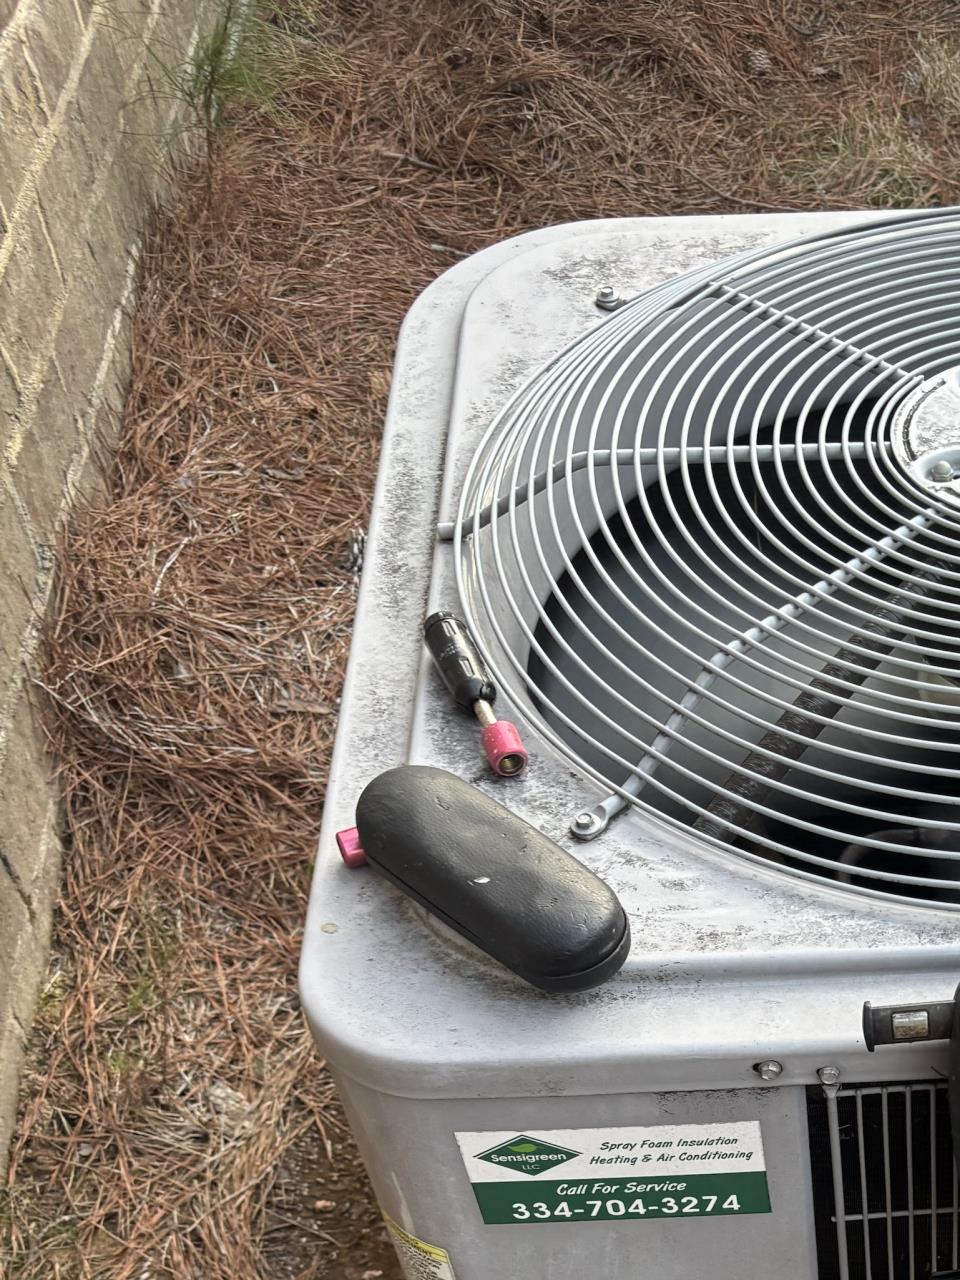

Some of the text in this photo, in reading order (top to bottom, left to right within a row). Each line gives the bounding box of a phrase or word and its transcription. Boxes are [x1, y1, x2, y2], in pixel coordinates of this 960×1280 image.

[600, 1137, 738, 1152] Spray Foam Insulation
[491, 1152, 567, 1163] Sensigreen
[589, 1150, 754, 1166] Heating & Air Conditioning
[556, 1181, 687, 1195] Call For Service
[512, 1194, 741, 1219] 334-704-3274
